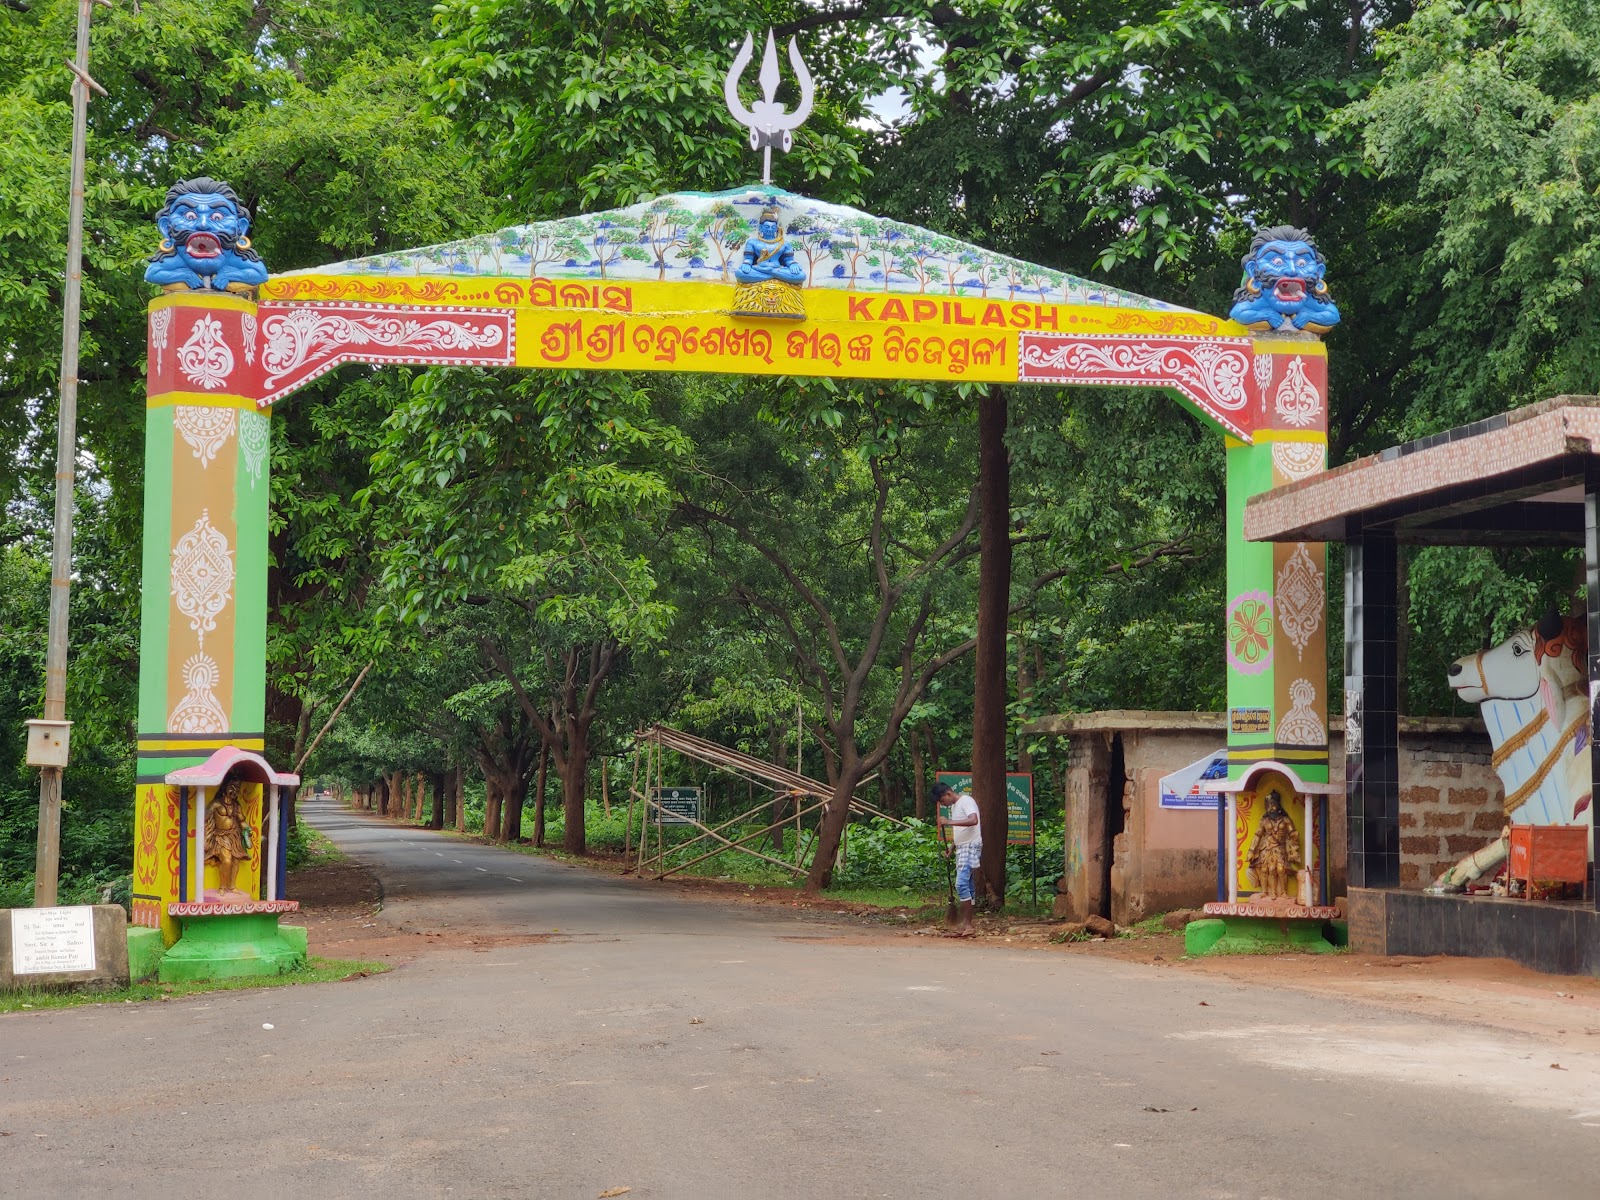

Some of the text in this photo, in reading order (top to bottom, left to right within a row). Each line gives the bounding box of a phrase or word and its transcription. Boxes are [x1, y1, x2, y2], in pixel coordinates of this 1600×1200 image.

[494, 277, 633, 312] କପିଳାସ
[848, 296, 1058, 330] KAPILASH
[632, 324, 775, 365] ଚନ୍ଦ୍ରଶେଖର
